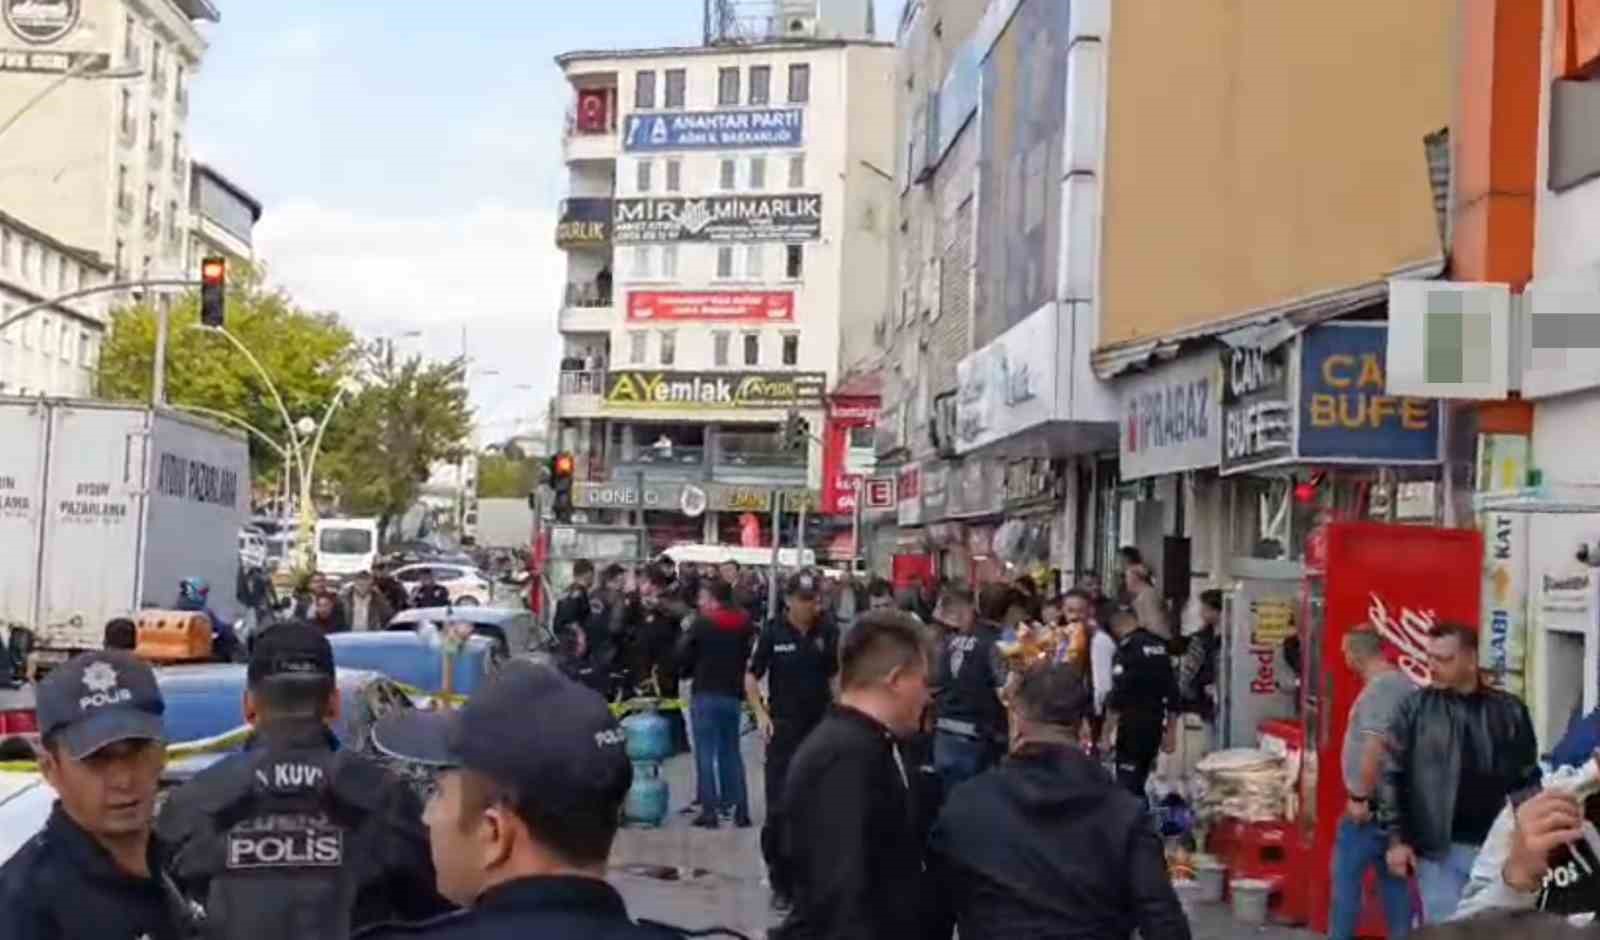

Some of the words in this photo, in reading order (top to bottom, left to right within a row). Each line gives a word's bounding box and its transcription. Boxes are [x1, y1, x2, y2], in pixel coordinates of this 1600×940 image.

[673, 111, 748, 129] ANAHTAR
[751, 109, 799, 127] PARTİ
[1321, 353, 1387, 389] CA
[871, 482, 892, 505] E
[1495, 517, 1513, 559] KAT
[230, 829, 339, 864] POLİS
